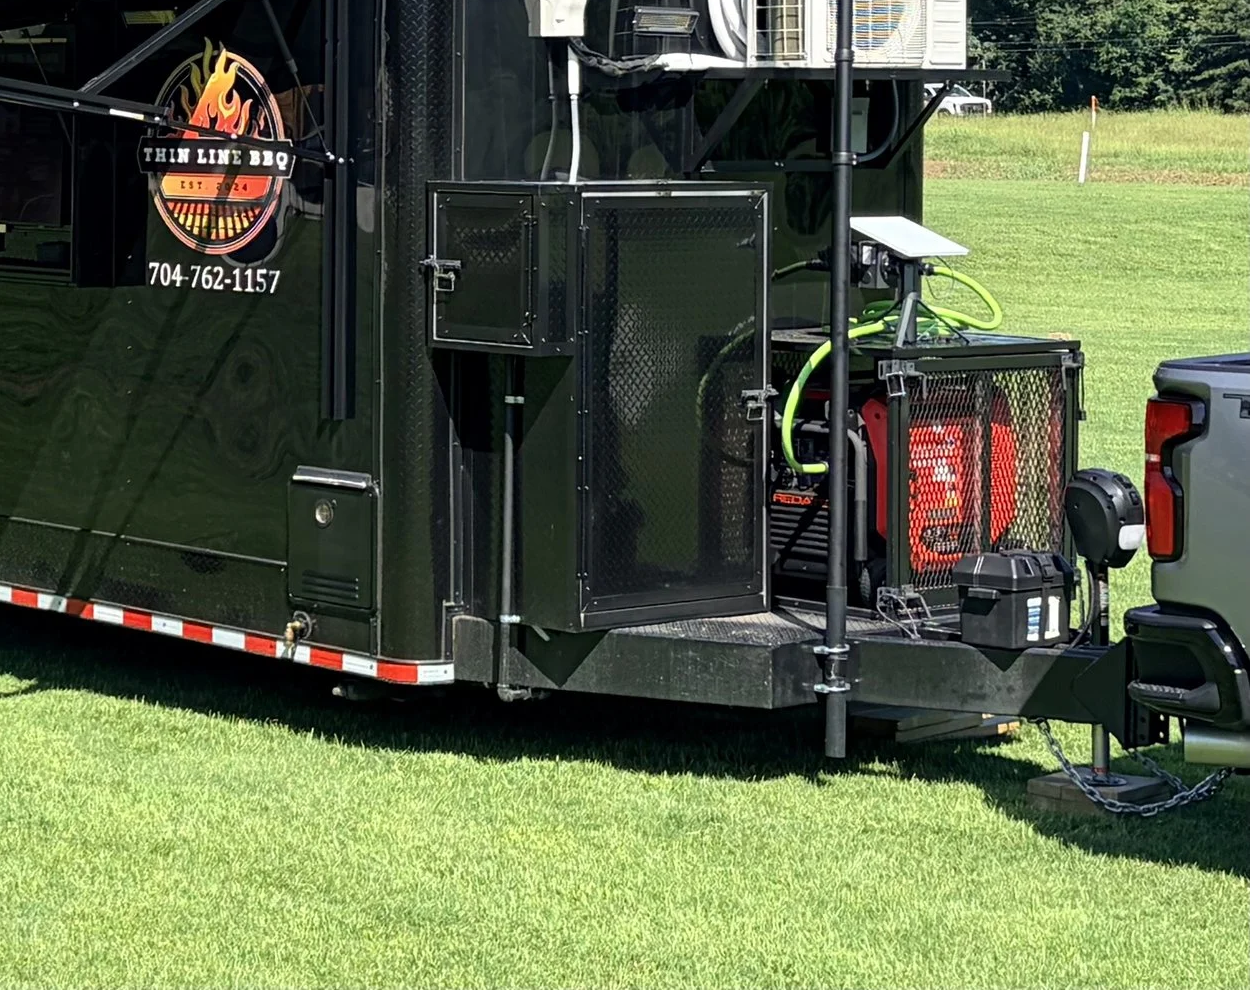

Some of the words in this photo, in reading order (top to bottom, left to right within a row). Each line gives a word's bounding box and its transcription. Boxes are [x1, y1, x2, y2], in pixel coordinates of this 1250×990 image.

[143, 147, 190, 164] THIN
[197, 148, 242, 165] LINE
[249, 150, 289, 170] BBQ
[180, 180, 208, 190] EST.
[148, 262, 281, 294] 704-762-1157
